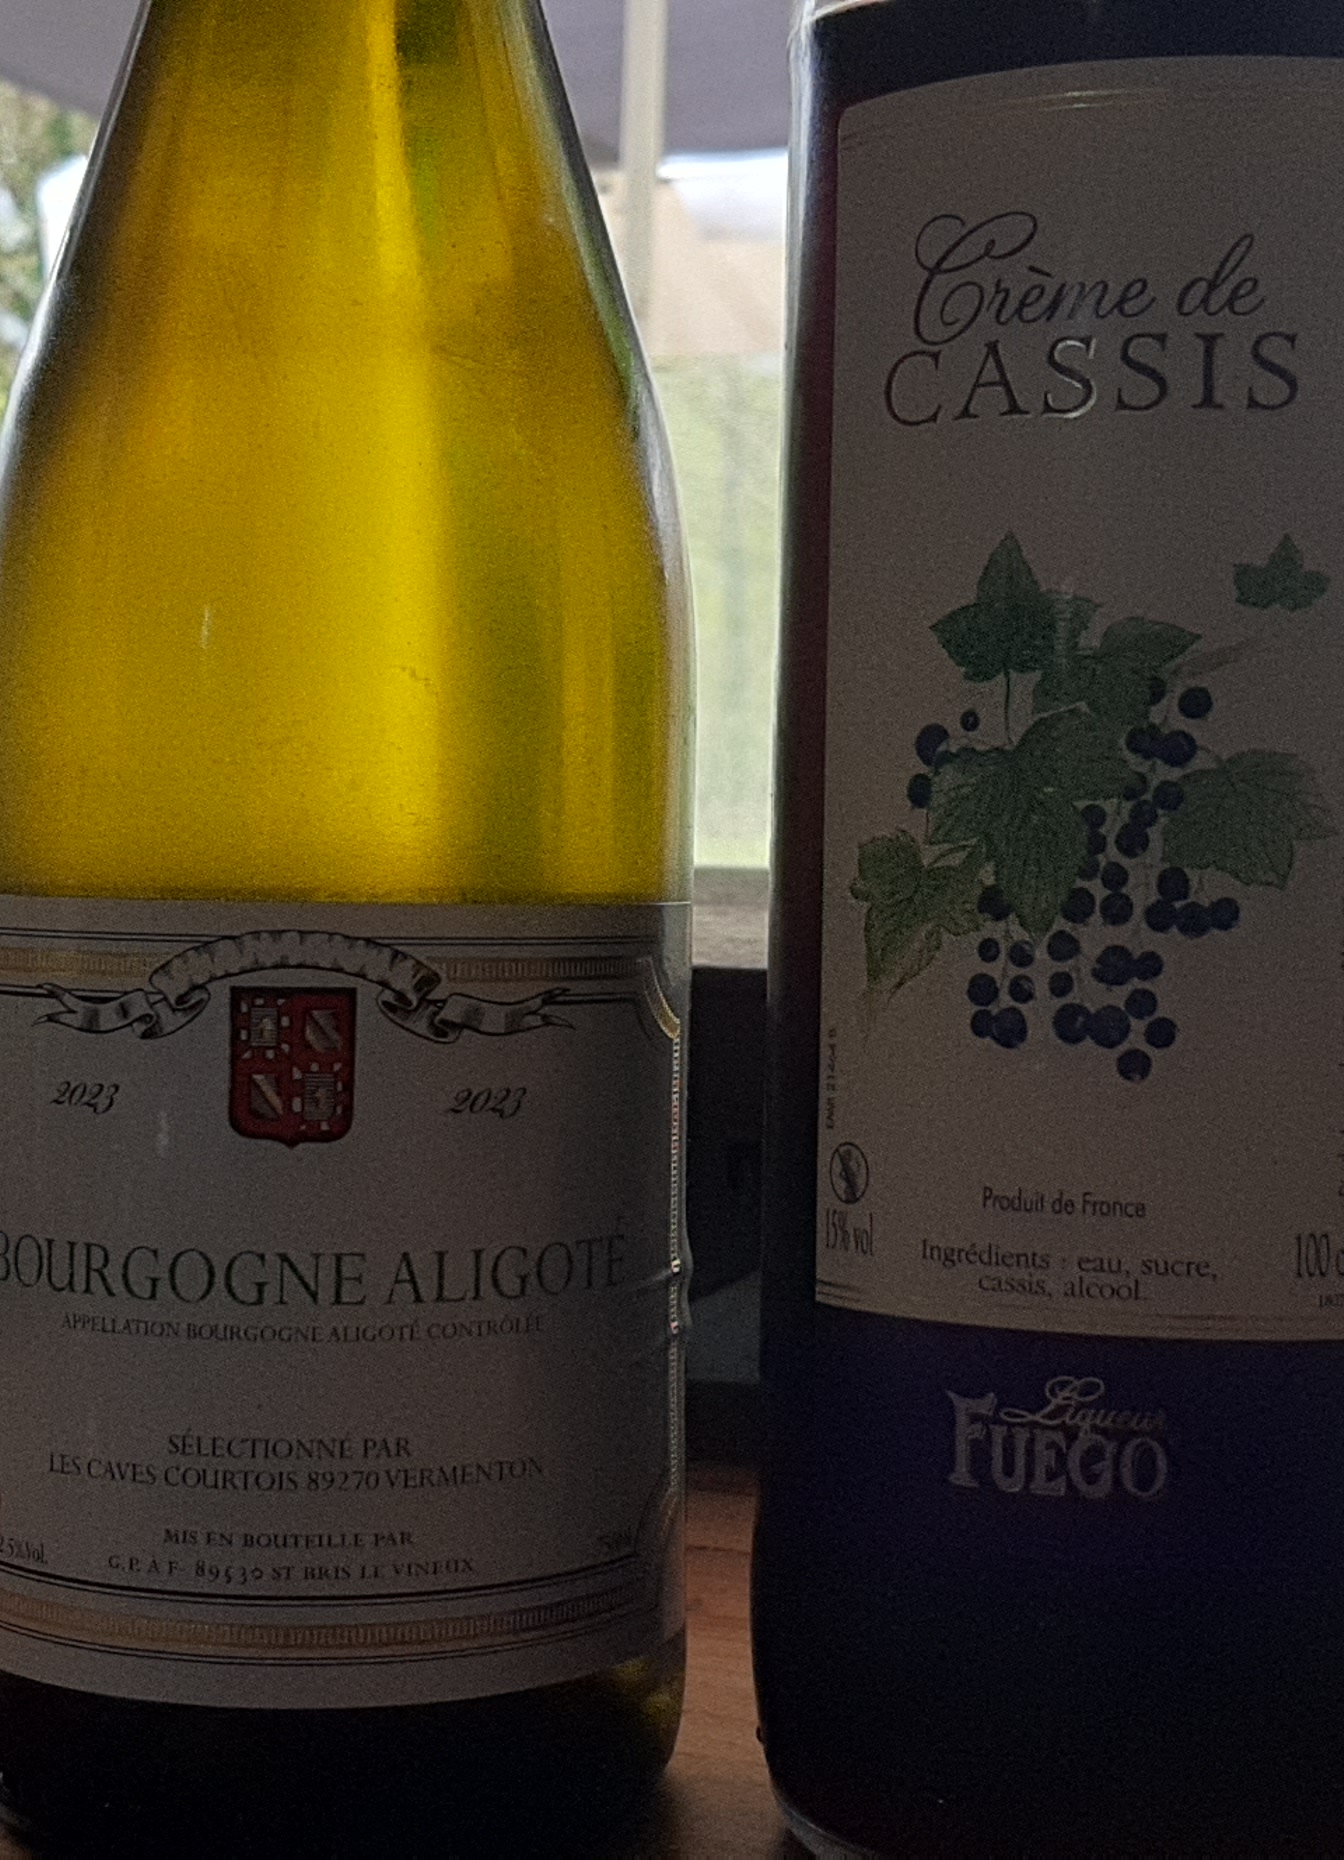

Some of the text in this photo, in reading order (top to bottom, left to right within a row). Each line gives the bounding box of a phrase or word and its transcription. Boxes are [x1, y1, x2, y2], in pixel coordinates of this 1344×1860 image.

[913, 210, 1265, 346] Crème de
[883, 331, 1300, 427] CASSIS
[51, 1080, 121, 1116] 2023
[445, 1085, 528, 1119] 2023
[982, 1186, 1148, 1219] Produit de France
[383, 1213, 627, 1306] ALIGOTÉ
[921, 1238, 1052, 1270] Ingrédients
[1076, 1254, 1131, 1278] eau,
[1140, 1255, 1219, 1283] sucre,
[1294, 1231, 1332, 1279] 100
[977, 1273, 1054, 1300] cassis,
[61, 1311, 546, 1344] APPELLATION BOURGOGNE ALIGOTÉ CONTRÔLÉE
[999, 1375, 1168, 1439] Liqueur
[166, 1427, 413, 1461] SÉLECTIONNÉ PAR
[942, 1387, 1170, 1499] FUEGO
[48, 1450, 546, 1493] LES CAVES COURTOIS 89270 VERMENTON
[163, 1528, 415, 1550] MIS EN BOUTEILLE PAR
[194, 1559, 265, 1586] 89530
[271, 1564, 296, 1581] ST
[303, 1565, 352, 1581] BRIS
[359, 1564, 384, 1580] LE
[392, 1557, 476, 1578] VINEUX
